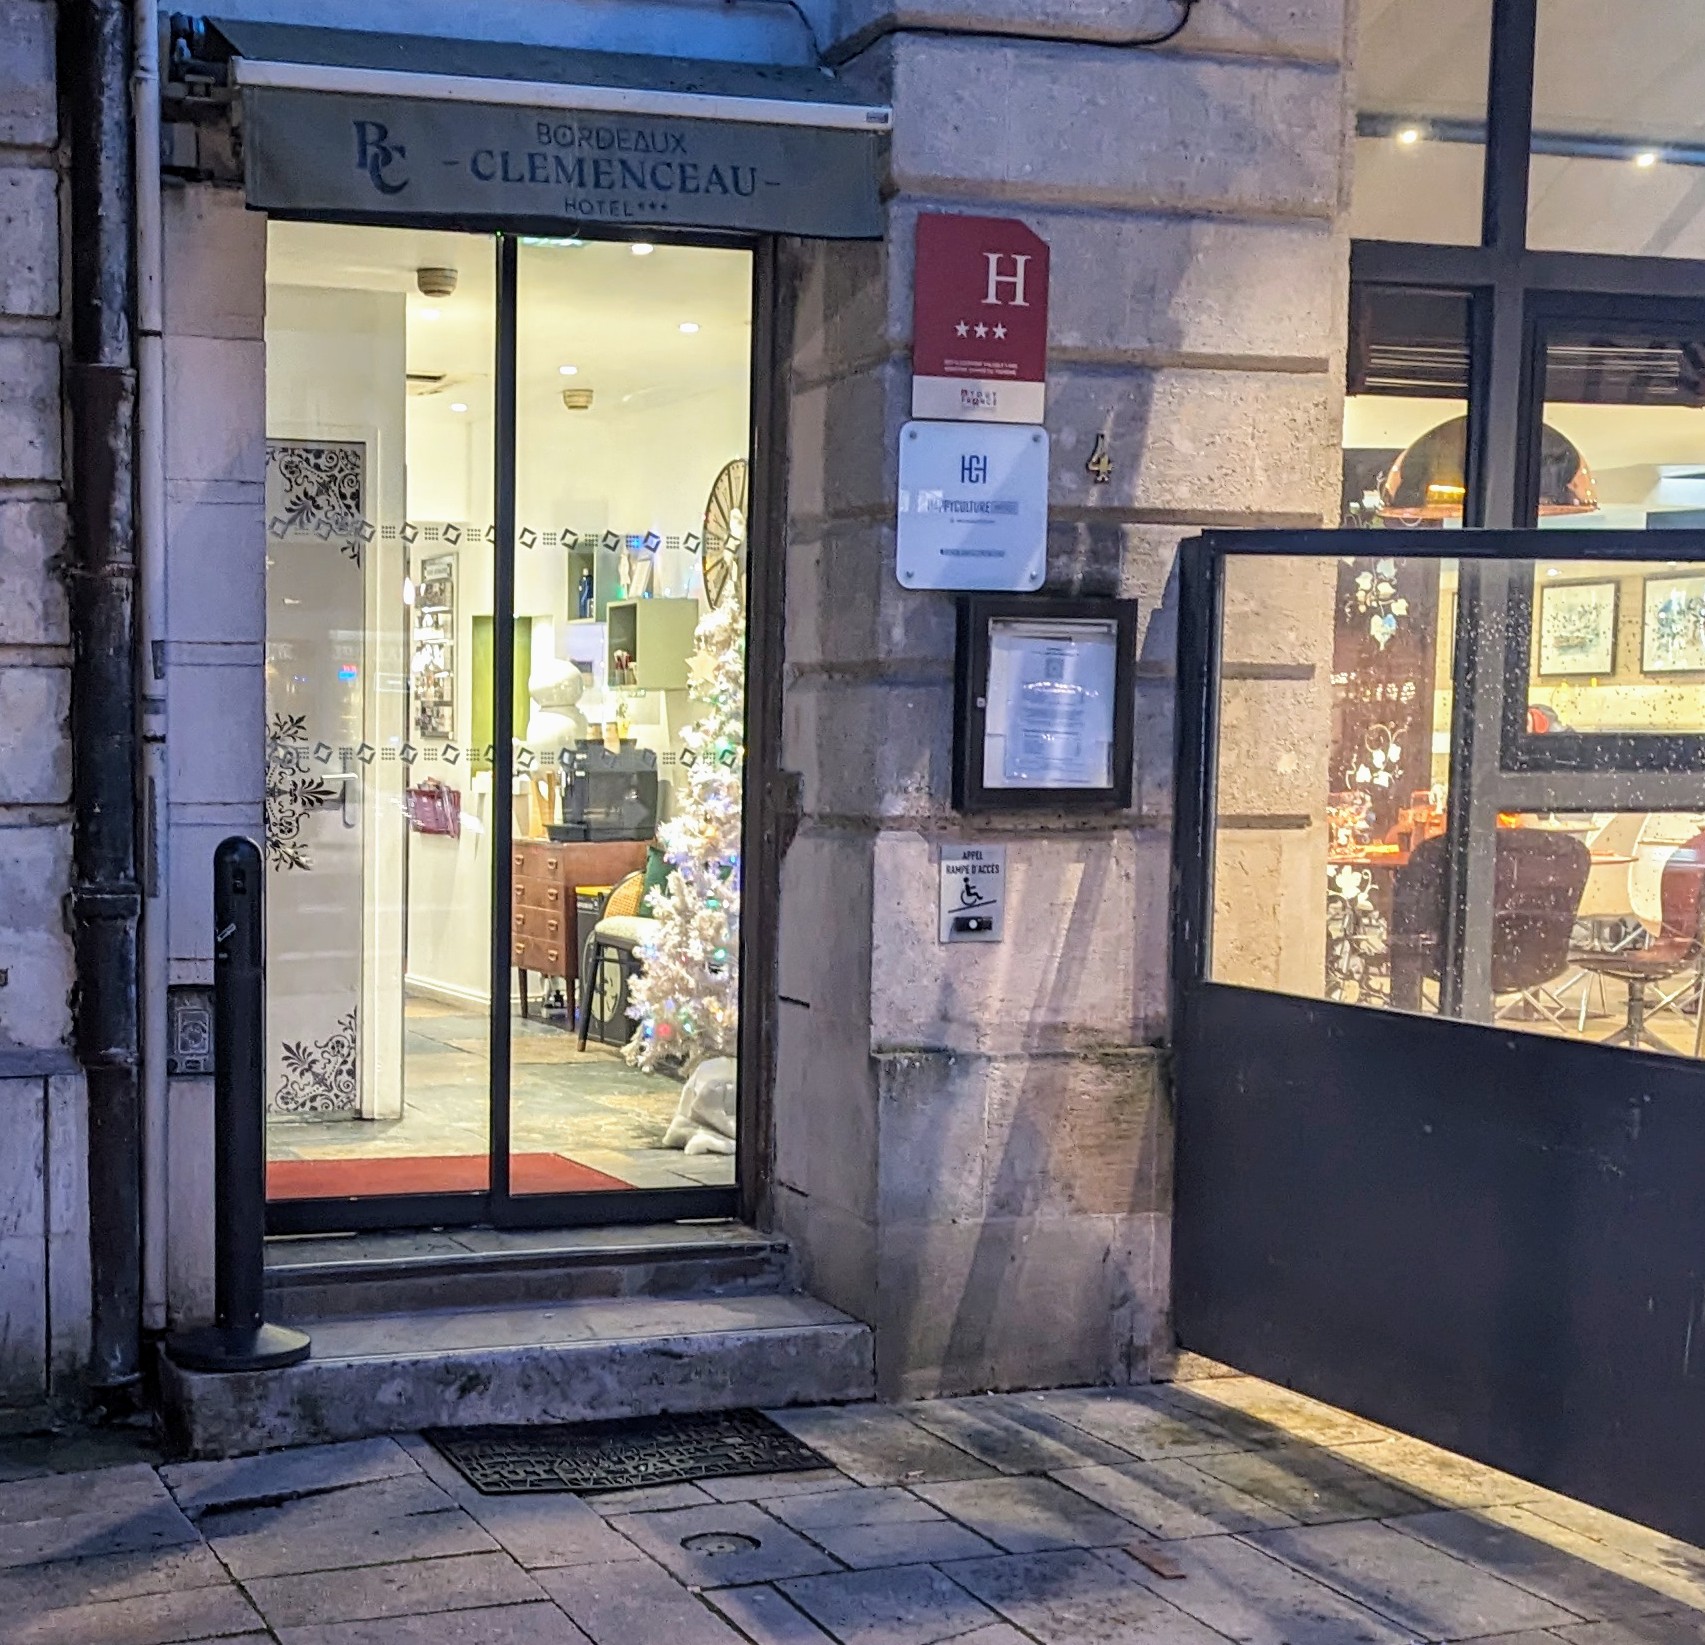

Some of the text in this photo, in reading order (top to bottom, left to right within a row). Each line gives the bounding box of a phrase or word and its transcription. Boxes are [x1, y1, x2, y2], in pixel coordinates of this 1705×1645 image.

[536, 121, 687, 155] BORDEAUX
[470, 149, 757, 198] CLEMENCEAU
[981, 252, 1032, 307] H
[1086, 433, 1114, 484] 4
[962, 850, 984, 860] APPEL
